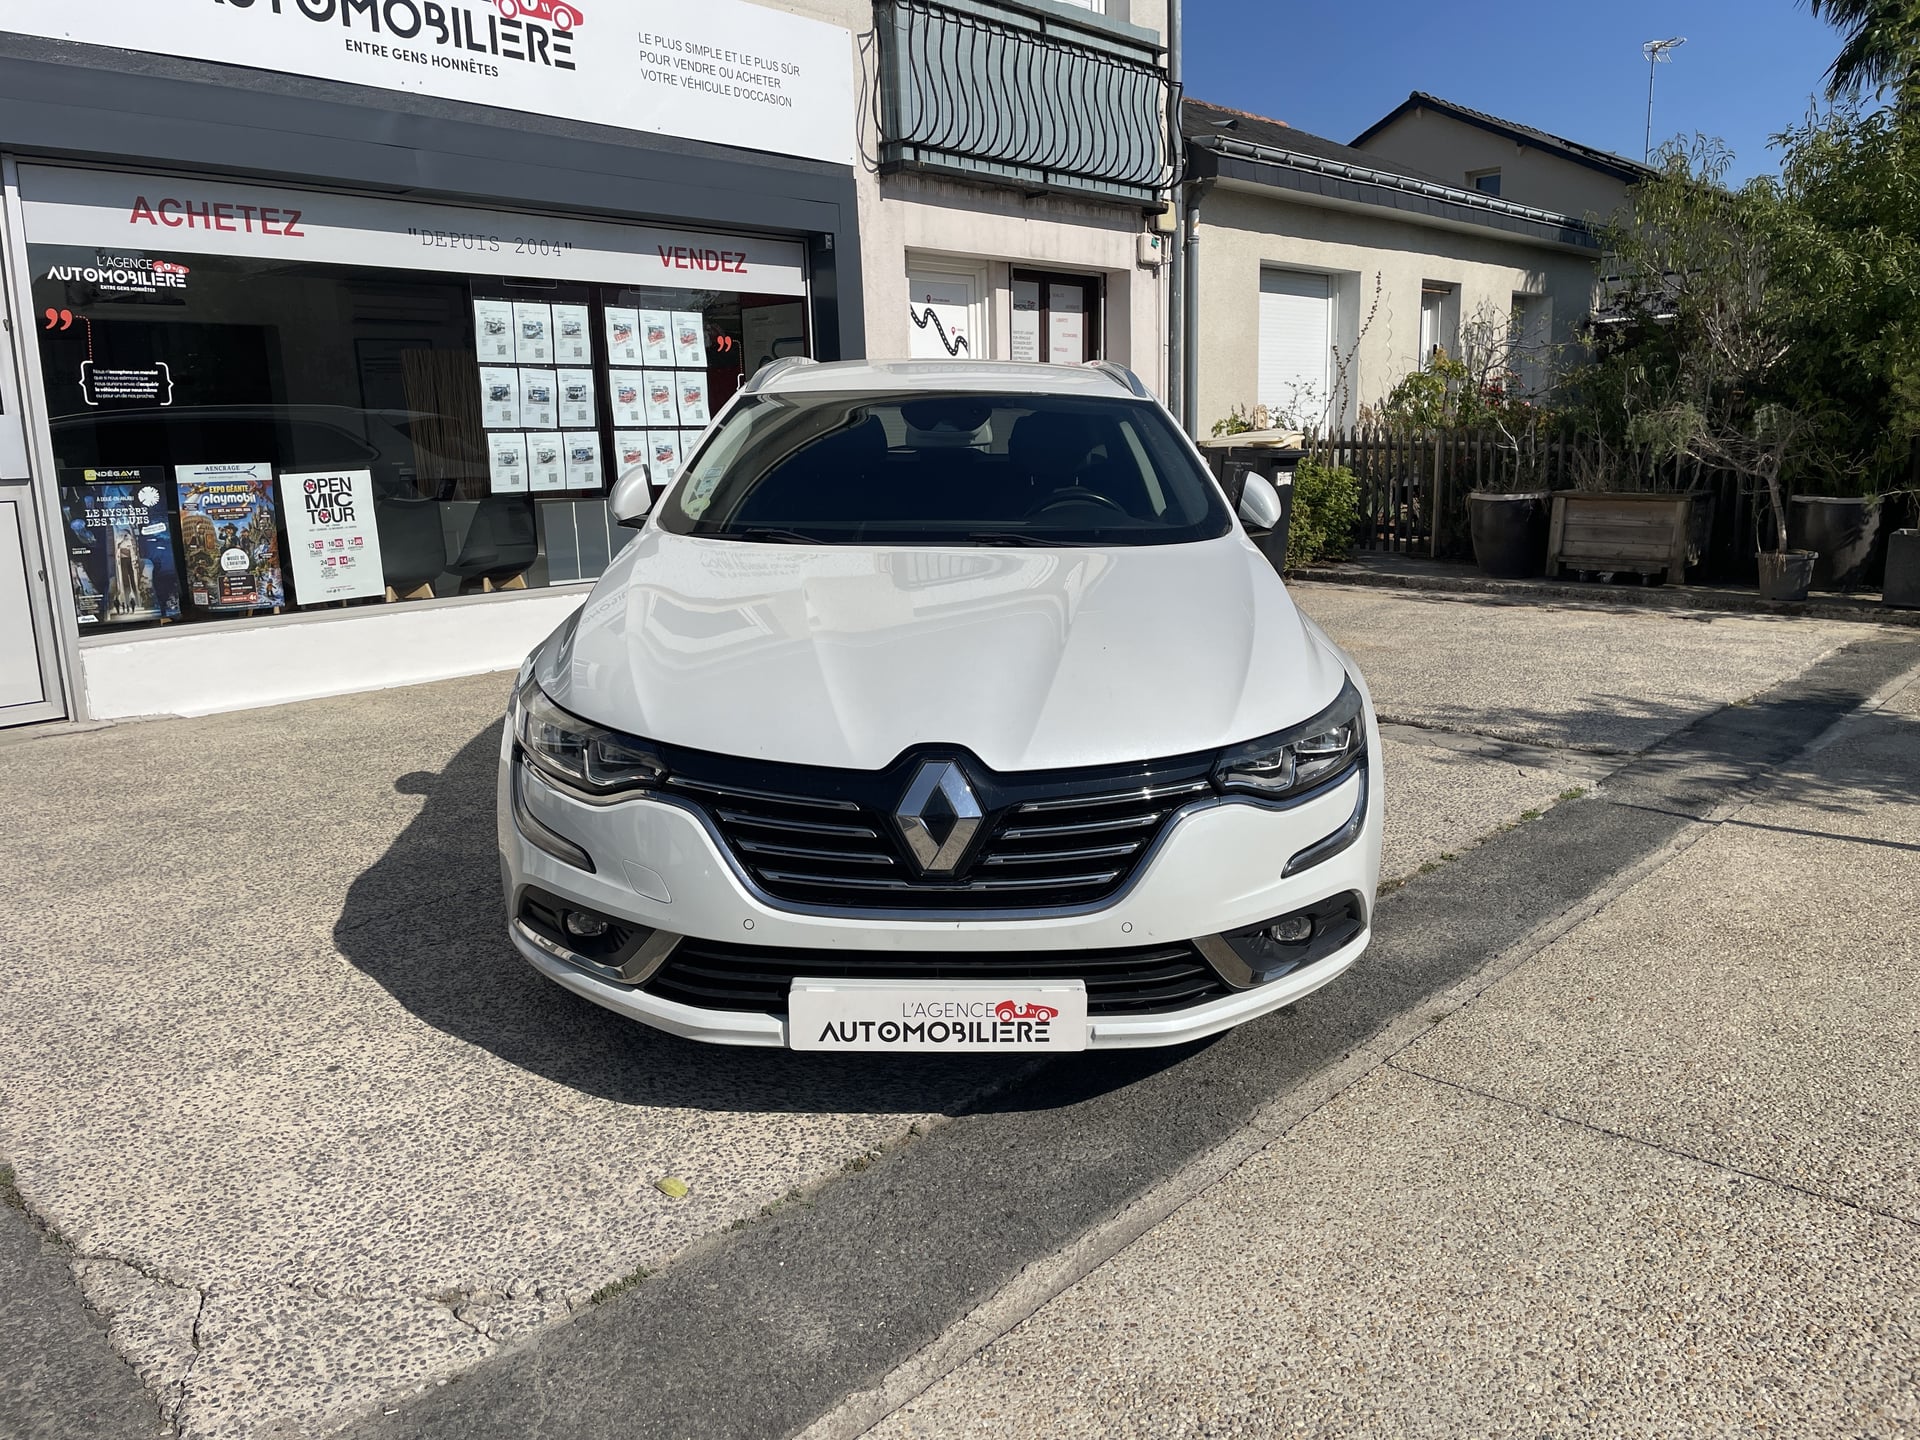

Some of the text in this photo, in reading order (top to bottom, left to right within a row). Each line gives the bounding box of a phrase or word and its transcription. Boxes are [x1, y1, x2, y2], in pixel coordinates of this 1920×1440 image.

[345, 39, 498, 77] ENTRE GENS HONNÊTES
[638, 32, 800, 77] LE PLUS SIMPLE ET LE PLUS SÛR
[640, 50, 781, 88] POUR VENDRE OU ACHETER
[641, 68, 792, 108] VOTRE VÉHICULE D'OCCASION
[130, 196, 304, 238] ACHETEZ
[96, 256, 152, 270] L'AGENCE
[657, 245, 748, 274] VENDEZ
[226, 484, 248, 493] GÉANTE
[303, 477, 352, 494] OPEN
[202, 493, 256, 508] playmobil
[305, 492, 353, 509] MIC
[85, 505, 148, 518] LE MYSTÈRE
[307, 507, 356, 524] TOUR
[87, 519, 108, 527] DES
[902, 1002, 996, 1018] L'AGENCE
